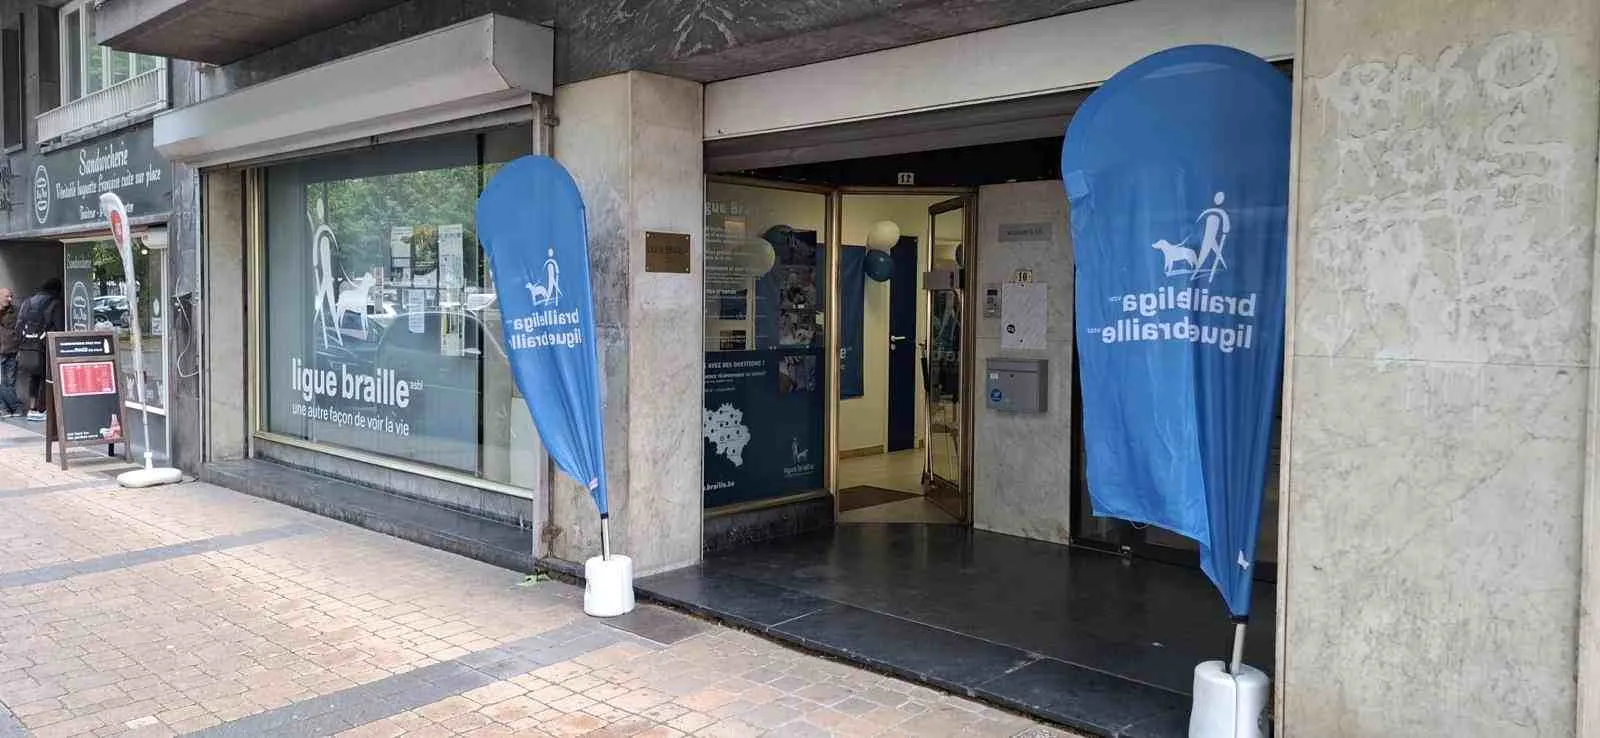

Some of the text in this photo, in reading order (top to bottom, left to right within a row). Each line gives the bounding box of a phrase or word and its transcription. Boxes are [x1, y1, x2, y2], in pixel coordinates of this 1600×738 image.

[79, 142, 128, 176] Sandwicherie
[135, 172, 145, 185] sur
[145, 162, 161, 188] place
[1018, 271, 1028, 281] 10
[291, 358, 338, 402] ligue
[342, 364, 410, 408] braille
[292, 401, 410, 437] une autre façon de voir la vie
[704, 480, 735, 491] .braille.be
